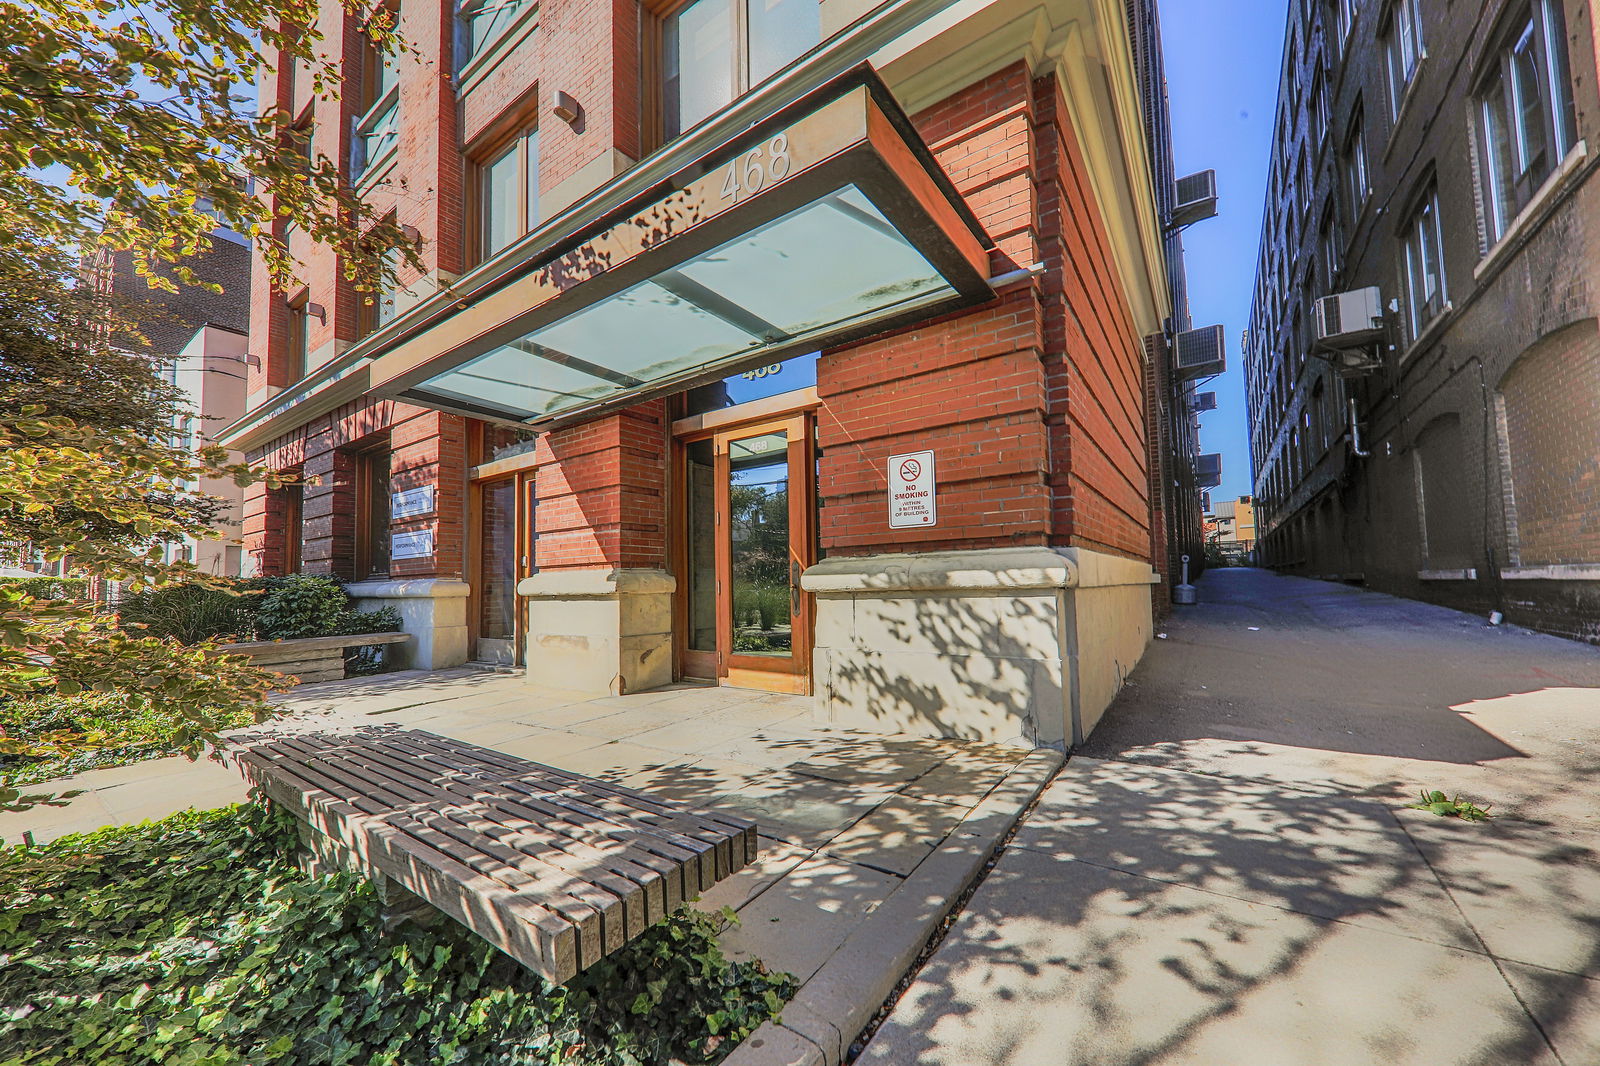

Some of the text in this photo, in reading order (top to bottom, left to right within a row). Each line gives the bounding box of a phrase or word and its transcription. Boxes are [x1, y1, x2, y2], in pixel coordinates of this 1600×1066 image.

[720, 133, 791, 204] 468
[749, 440, 768, 453] 468
[894, 490, 928, 500] SMOKING
